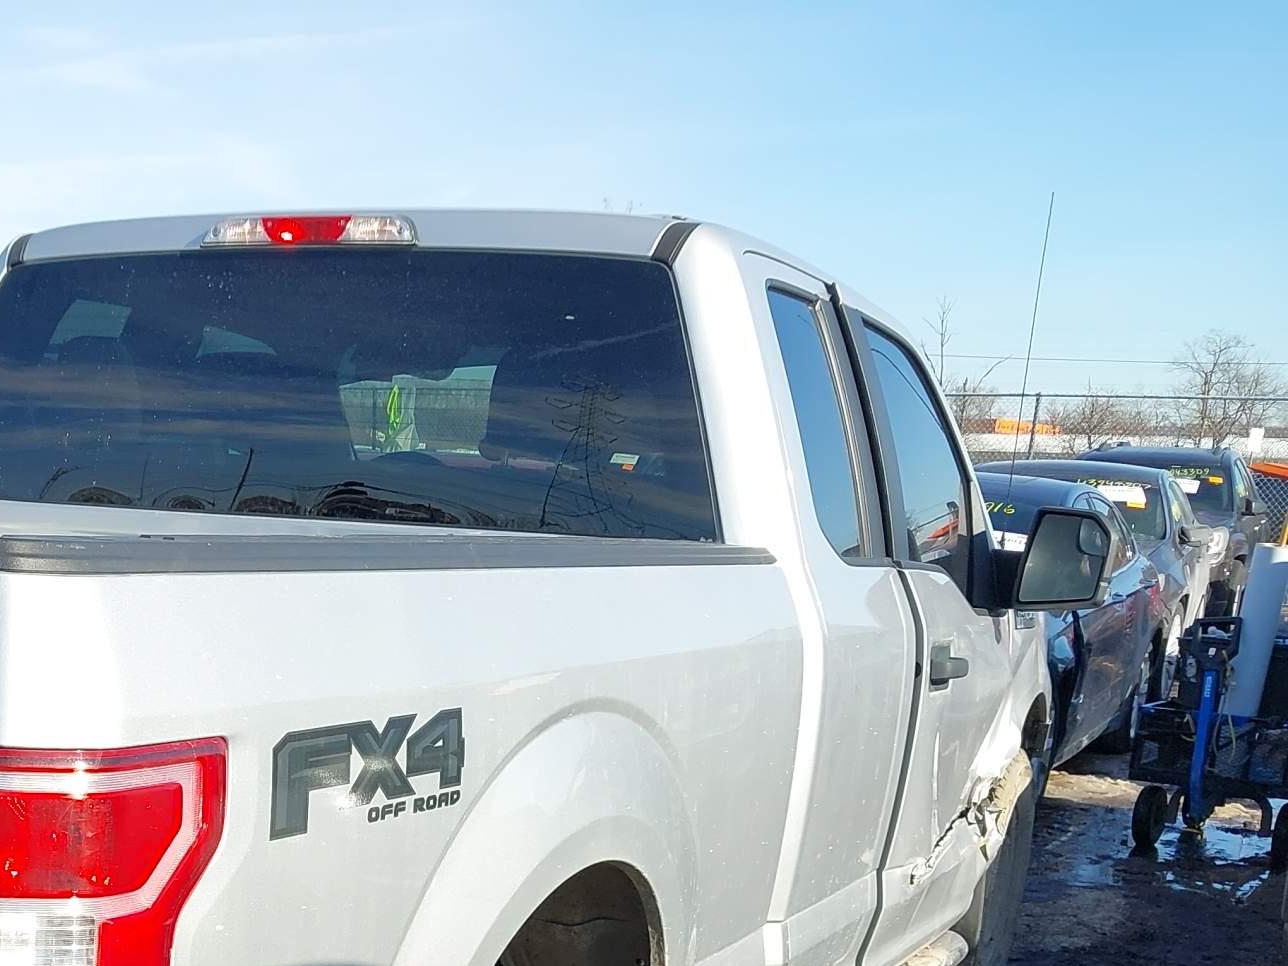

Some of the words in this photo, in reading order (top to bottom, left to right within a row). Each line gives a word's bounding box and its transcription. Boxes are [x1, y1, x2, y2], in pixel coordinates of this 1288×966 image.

[270, 707, 465, 841] FX4
[367, 802, 407, 824] OFF
[413, 790, 461, 814] ROAD
